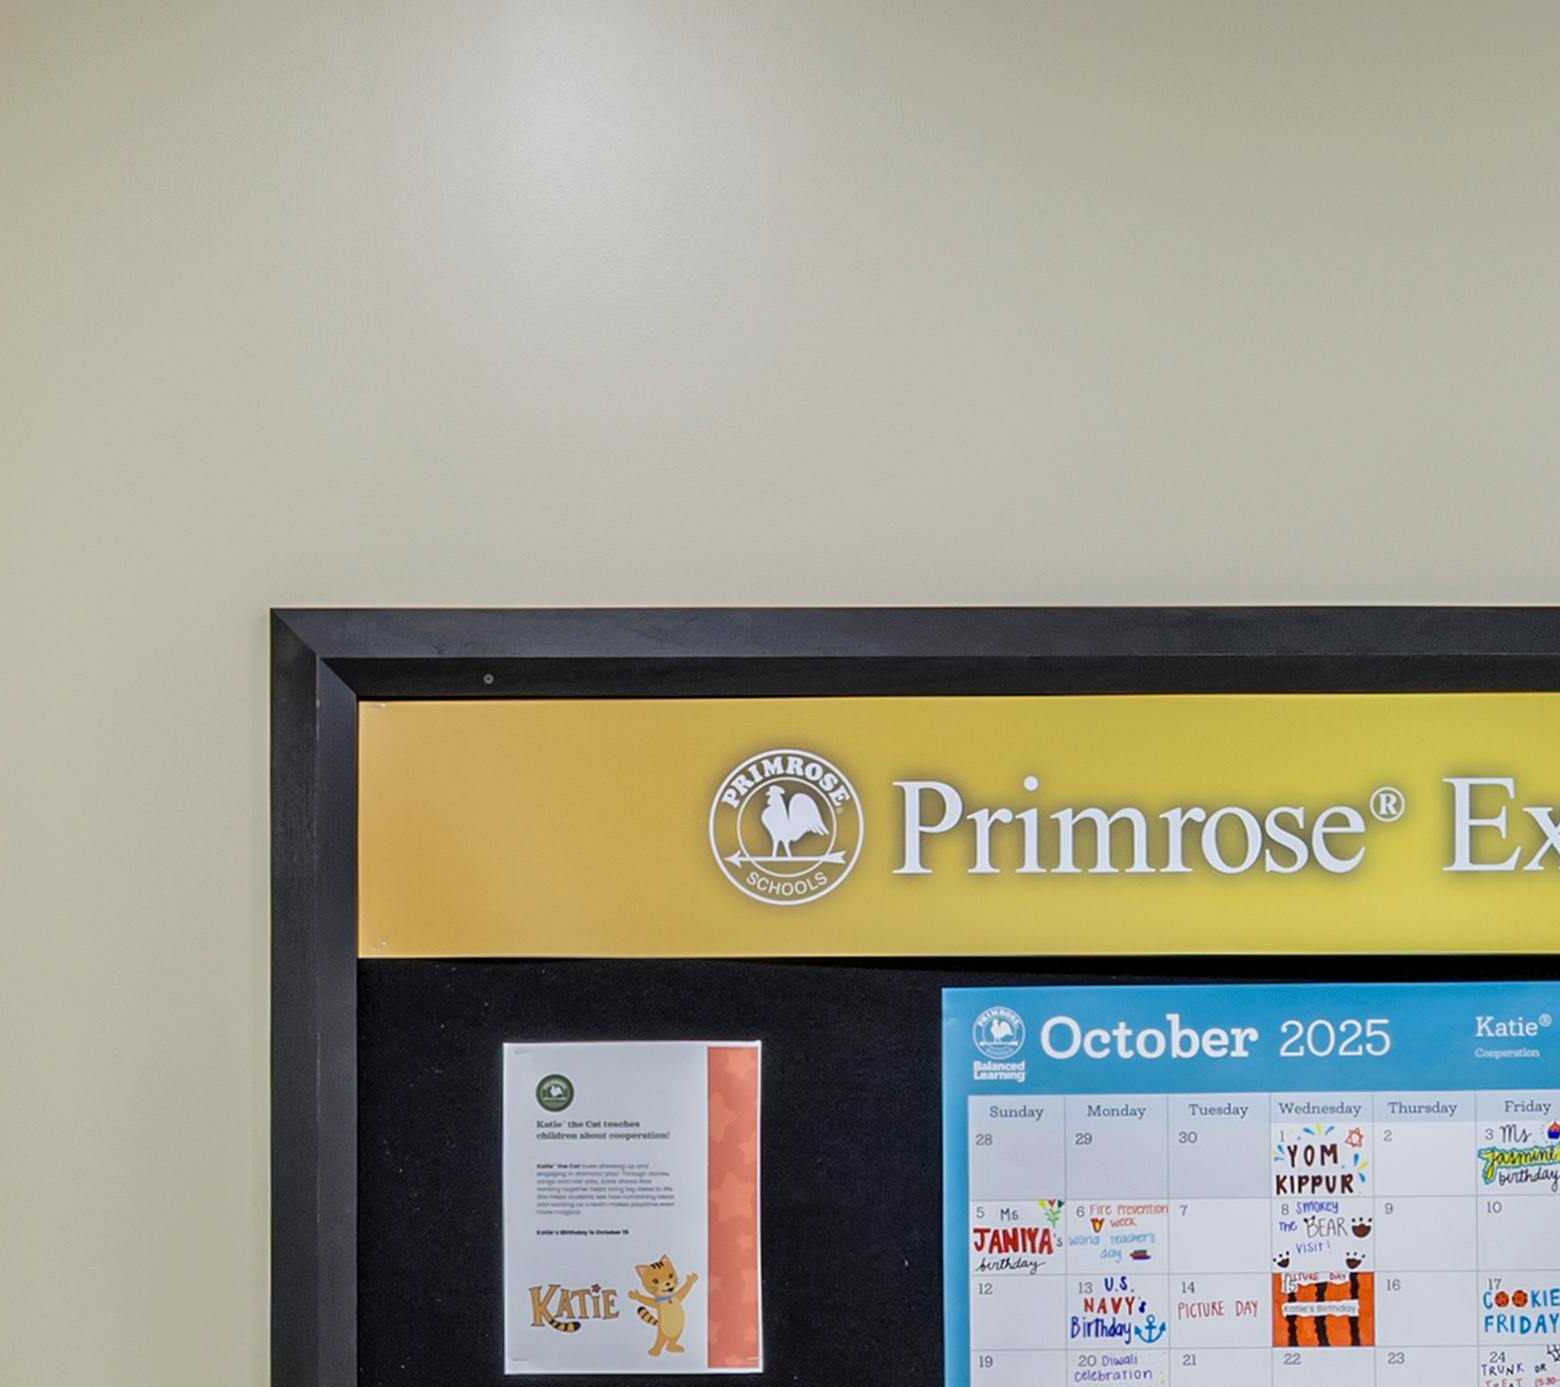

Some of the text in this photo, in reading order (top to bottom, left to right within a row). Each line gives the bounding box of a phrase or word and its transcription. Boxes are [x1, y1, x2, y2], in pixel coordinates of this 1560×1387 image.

[722, 757, 851, 810] PRIMROSE
[745, 869, 829, 897] SCHOOLS
[1040, 1013, 1391, 1059] October 2025
[1475, 1048, 1540, 1060] Cooperation
[973, 1060, 1026, 1072] Balanced
[989, 1105, 1045, 1121] Sunday
[1087, 1104, 1146, 1120] Monday
[1188, 1103, 1248, 1119] Tuesday
[1279, 1102, 1362, 1117] Wednesday
[1388, 1101, 1458, 1116] Thursday
[1504, 1100, 1552, 1115] Friday
[603, 1120, 640, 1128] teaches
[536, 1131, 578, 1139] children
[579, 1131, 607, 1139] about
[975, 1133, 993, 1146] 28
[1075, 1132, 1093, 1145] 29
[1178, 1131, 1198, 1144] 30
[1384, 1130, 1392, 1142] 2
[1484, 1128, 1494, 1141] 3
[1287, 1143, 1338, 1167] YOM
[1275, 1173, 1354, 1196] KIPPUR
[976, 1206, 985, 1219] 5
[1076, 1205, 1085, 1217] 6
[1180, 1205, 1188, 1216] 7
[1281, 1203, 1289, 1215] 8
[1385, 1203, 1393, 1214] 9
[1486, 1201, 1502, 1213] 10
[1304, 1217, 1348, 1238] BEAR
[1100, 1248, 1122, 1263] day
[976, 1257, 1046, 1275] birthday
[978, 1283, 993, 1295] 12
[1078, 1282, 1093, 1294] 13
[1104, 1276, 1135, 1293] U.S.
[1182, 1281, 1195, 1293] 14
[1283, 1279, 1297, 1292] 15
[1385, 1279, 1400, 1291] 16
[1488, 1278, 1502, 1290] 17
[1178, 1300, 1259, 1320] PICTURE DAY
[1316, 1303, 1357, 1315] Birthday
[1070, 1316, 1132, 1344] Birthday
[1484, 1313, 1560, 1334] FRIDAY
[978, 1355, 993, 1368] 19
[1078, 1355, 1097, 1367] 20
[1182, 1354, 1196, 1366] 21
[1284, 1353, 1301, 1365] 22
[1387, 1352, 1405, 1365] 23
[1490, 1351, 1506, 1363] 24
[1481, 1363, 1547, 1376] TRUNK OR
